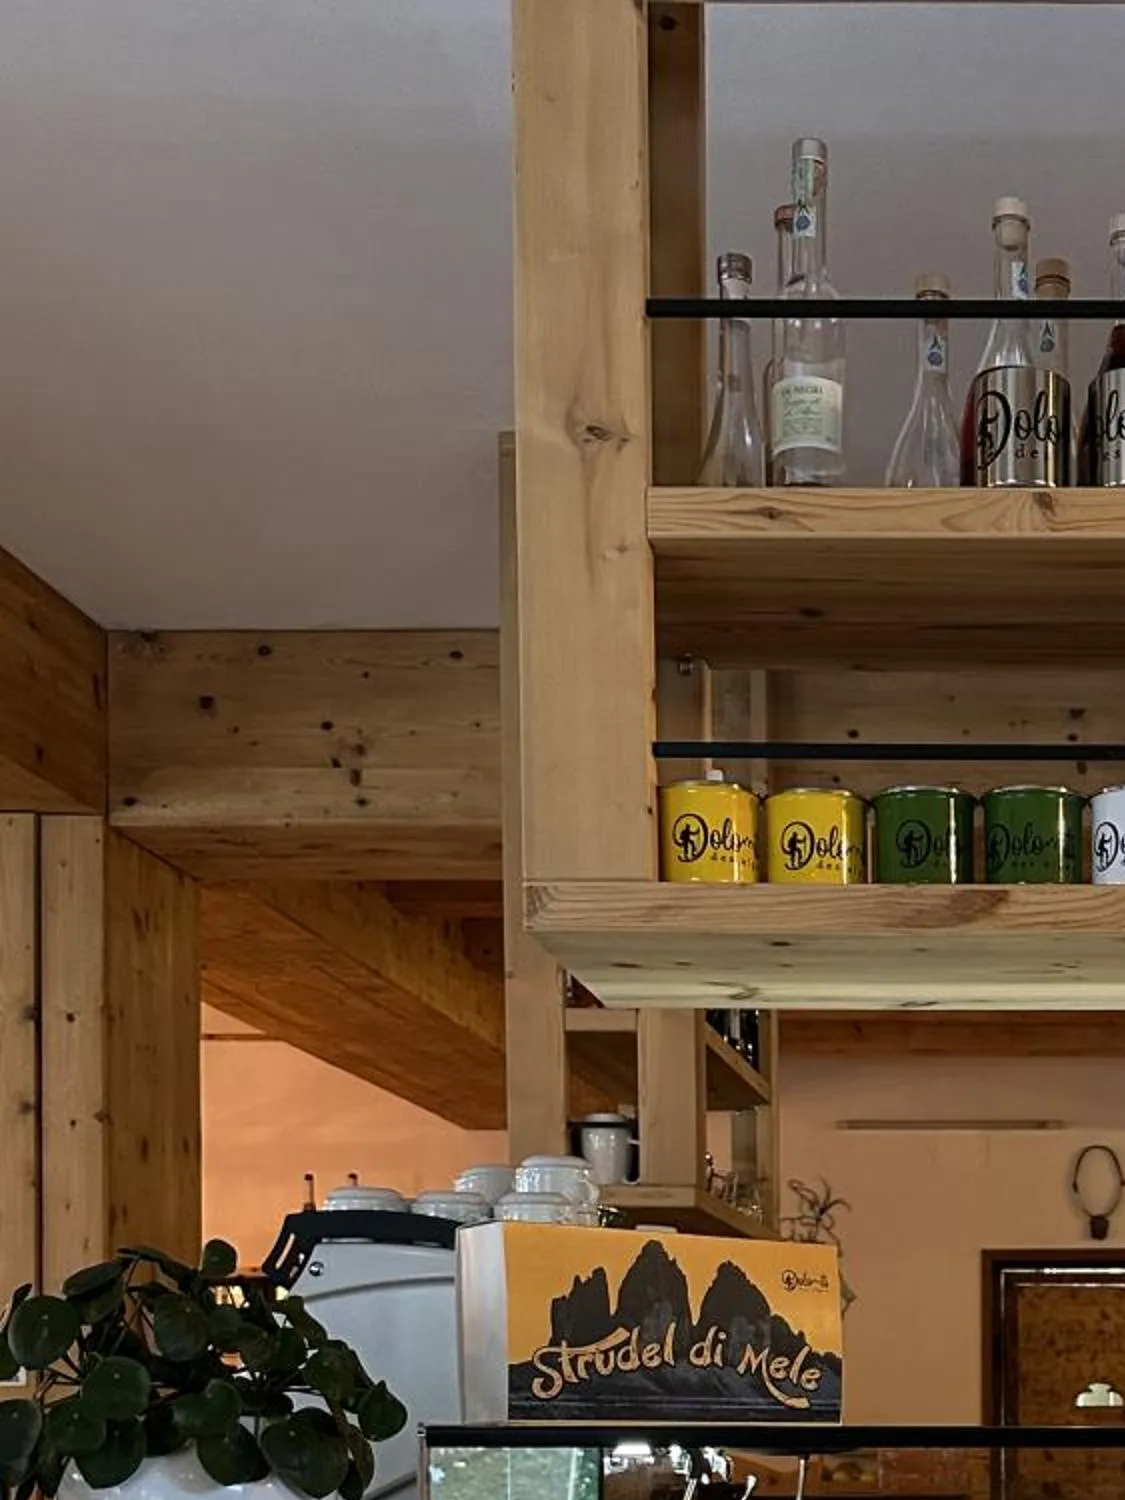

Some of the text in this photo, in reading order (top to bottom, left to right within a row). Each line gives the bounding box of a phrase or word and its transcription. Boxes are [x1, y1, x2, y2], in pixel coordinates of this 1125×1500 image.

[532, 1321, 822, 1409] Strudel di Mele
